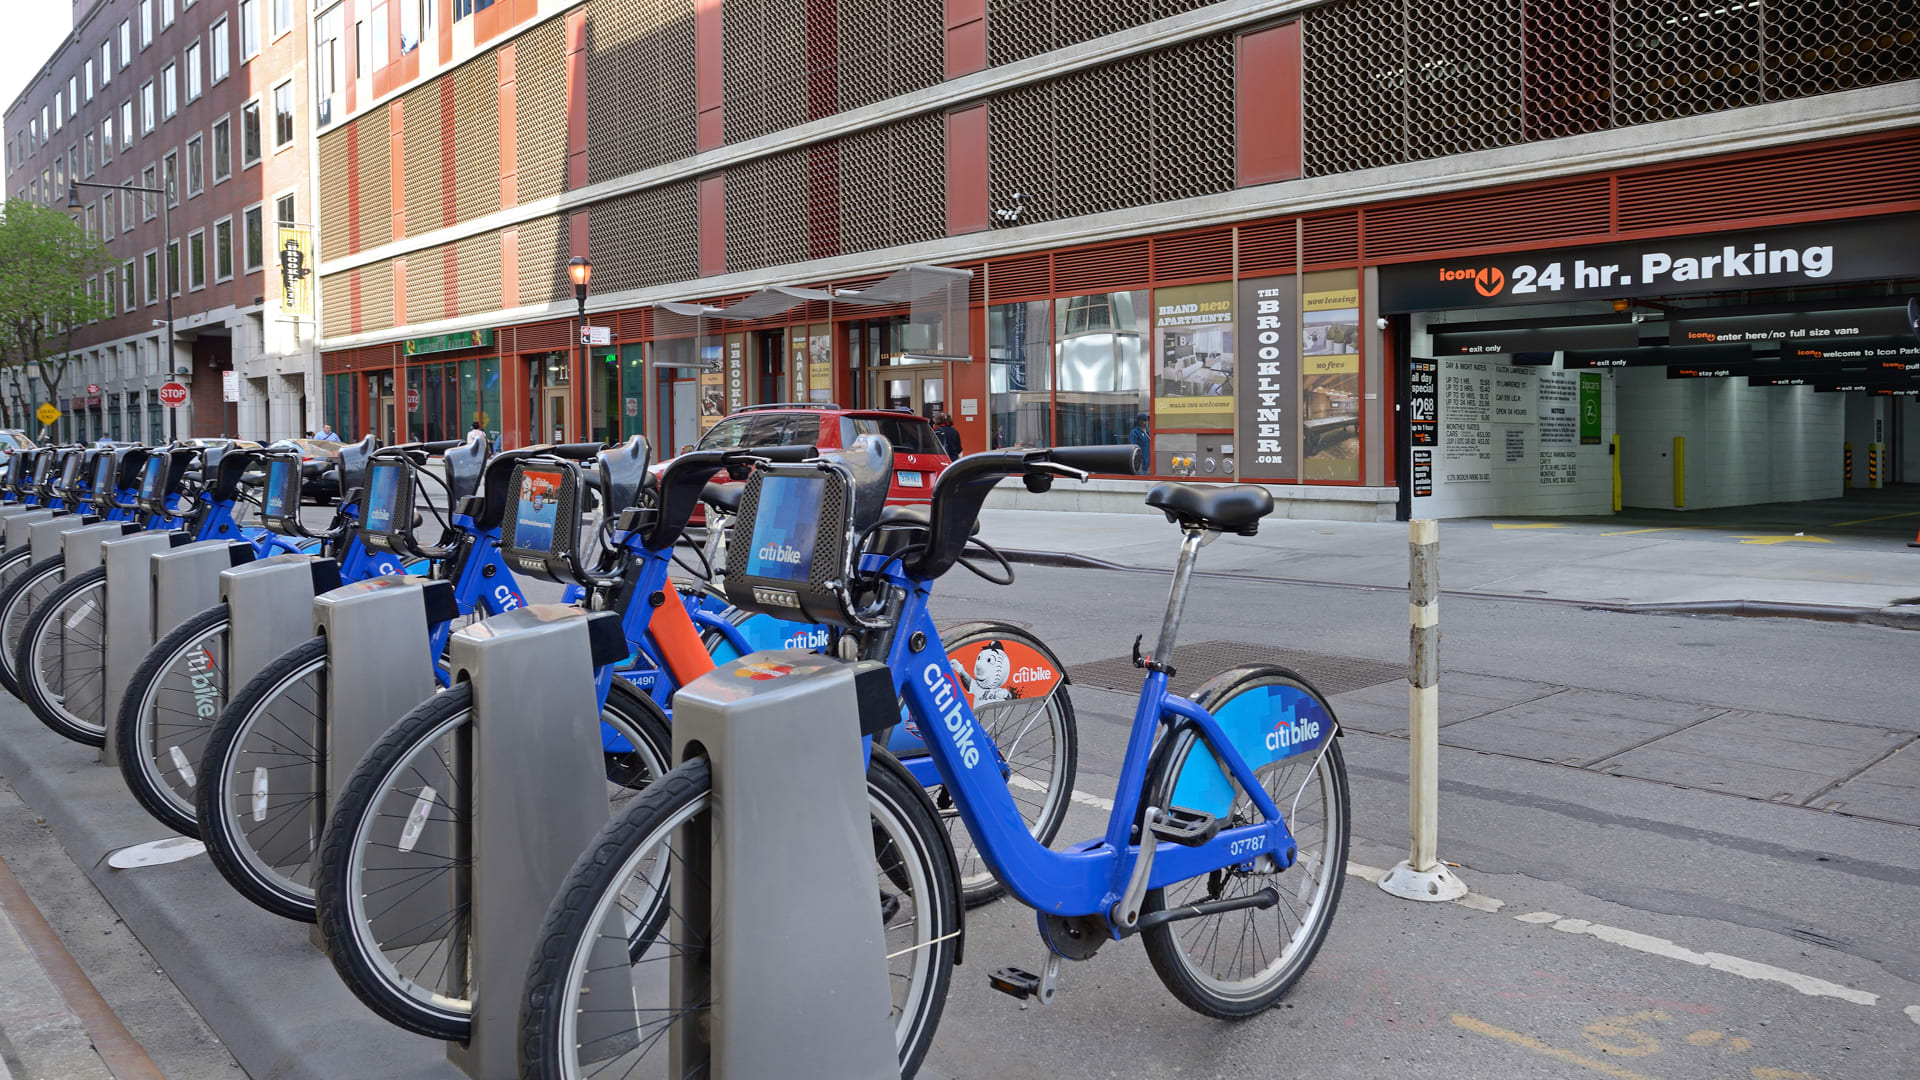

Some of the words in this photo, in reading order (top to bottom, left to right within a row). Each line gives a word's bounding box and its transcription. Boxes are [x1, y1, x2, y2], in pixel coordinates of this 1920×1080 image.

[1439, 267, 1476, 282] icon
[1512, 261, 1565, 294] 24
[1574, 257, 1632, 290] hr.
[1641, 242, 1834, 284] Parking
[1257, 289, 1279, 298] THE
[1324, 296, 1356, 304] leasing
[1158, 304, 1198, 315] BRAND
[1200, 300, 1230, 312] new
[1158, 312, 1232, 326] APARTMENTS
[1745, 330, 1786, 340] here/no
[1790, 329, 1805, 337] full
[1326, 360, 1344, 370] fees
[1256, 300, 1282, 452] BROOKLYNER
[1421, 373, 1432, 384] day
[161, 389, 186, 398] STOP
[1412, 384, 1433, 394] special
[1256, 456, 1282, 464] .COM
[495, 585, 518, 612] cit
[626, 676, 655, 686] 4490
[1231, 835, 1265, 856] 07787
